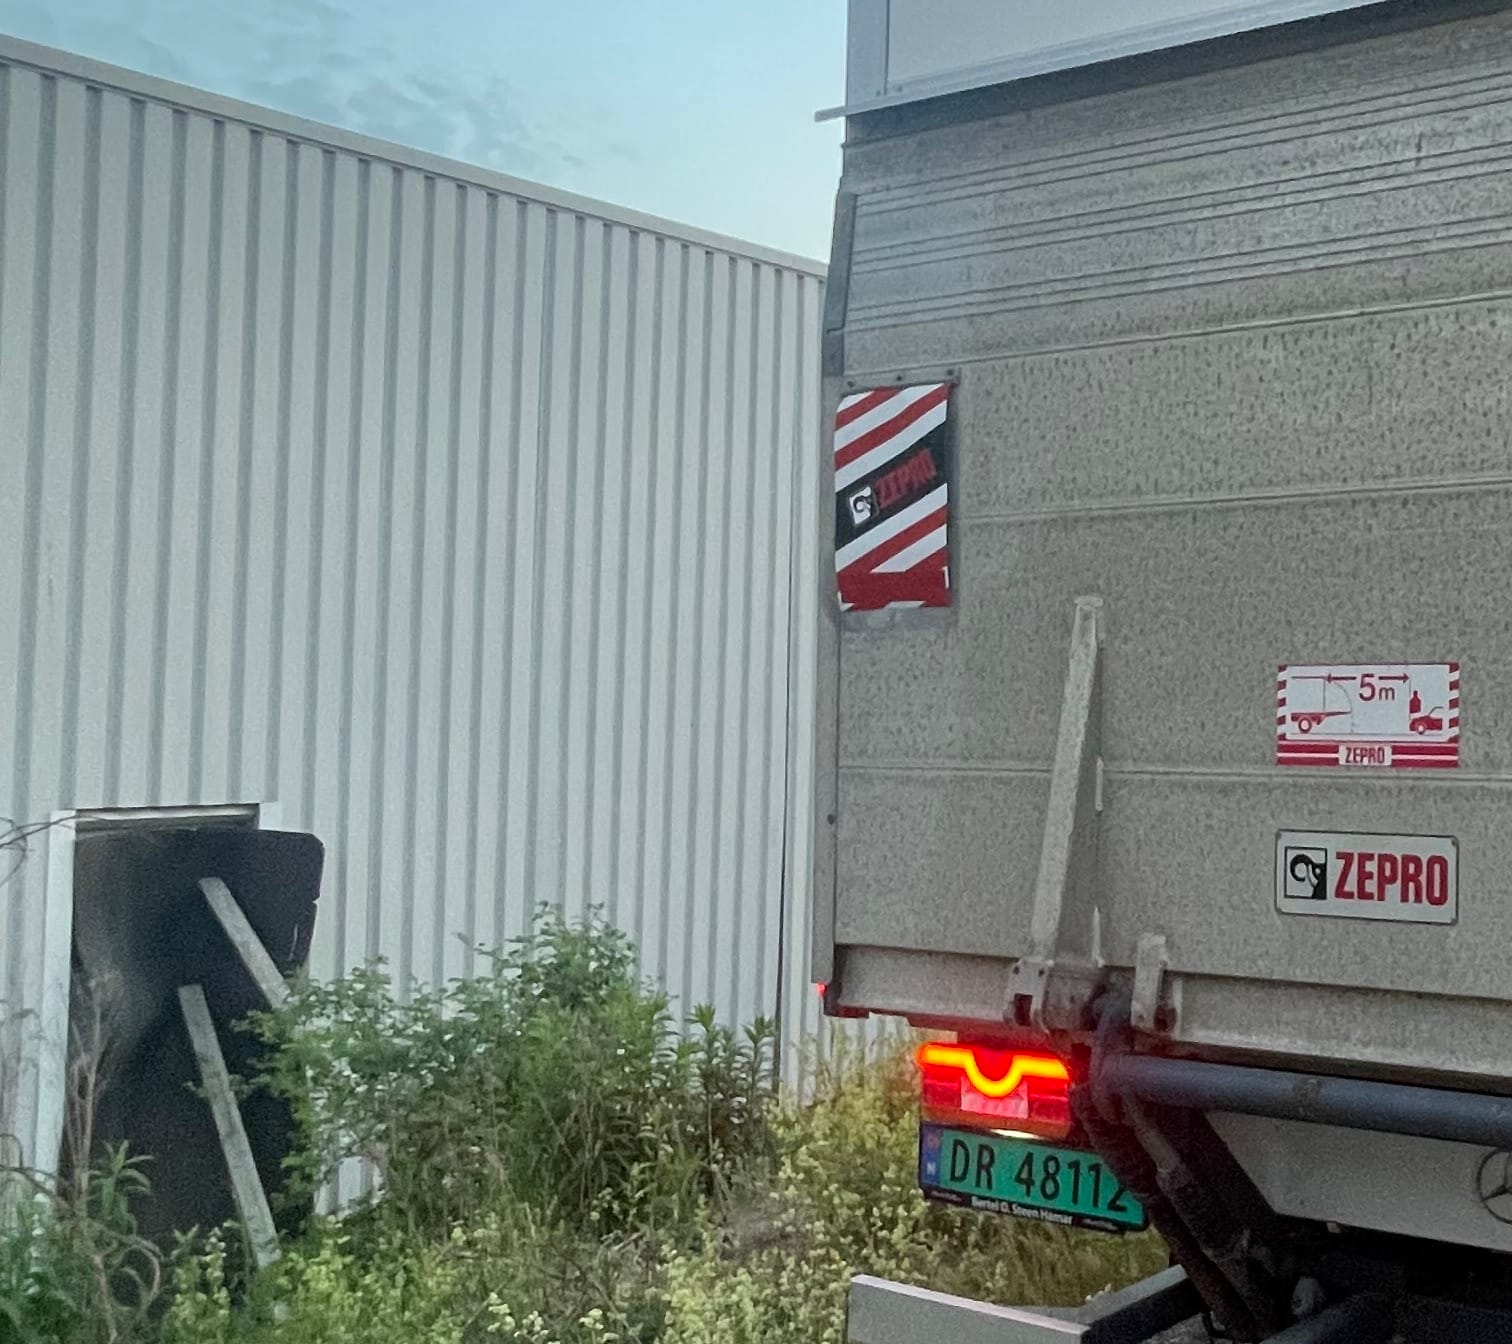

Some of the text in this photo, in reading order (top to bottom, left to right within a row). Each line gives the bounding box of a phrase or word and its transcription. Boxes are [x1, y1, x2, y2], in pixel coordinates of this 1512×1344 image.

[1345, 746, 1386, 765] ZEPRO
[1334, 851, 1449, 906] ZEPRO
[926, 1162, 936, 1176] N
[950, 1138, 995, 1191] DR
